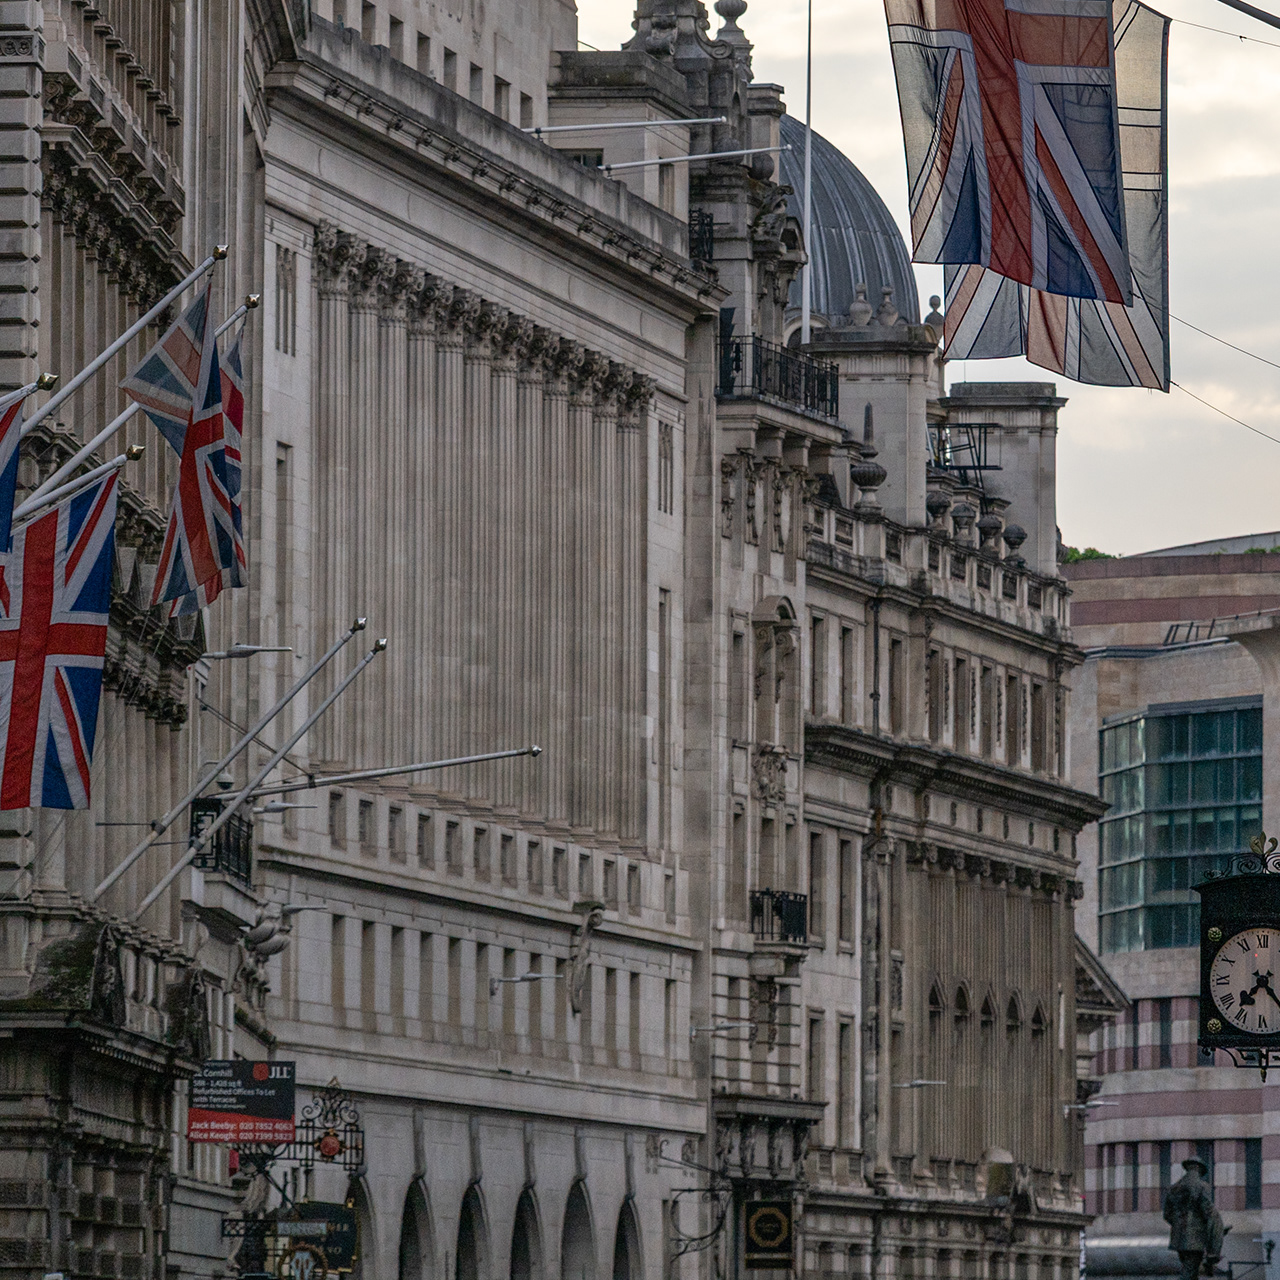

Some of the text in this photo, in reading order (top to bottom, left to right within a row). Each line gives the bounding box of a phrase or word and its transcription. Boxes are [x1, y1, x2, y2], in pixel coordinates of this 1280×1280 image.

[1256, 934, 1269, 949] XII
[202, 1068, 233, 1078] Cornhill
[269, 1066, 290, 1079] JLL
[191, 1122, 208, 1130] Jack
[239, 1122, 253, 1130] 020
[239, 1132, 254, 1140] 020
